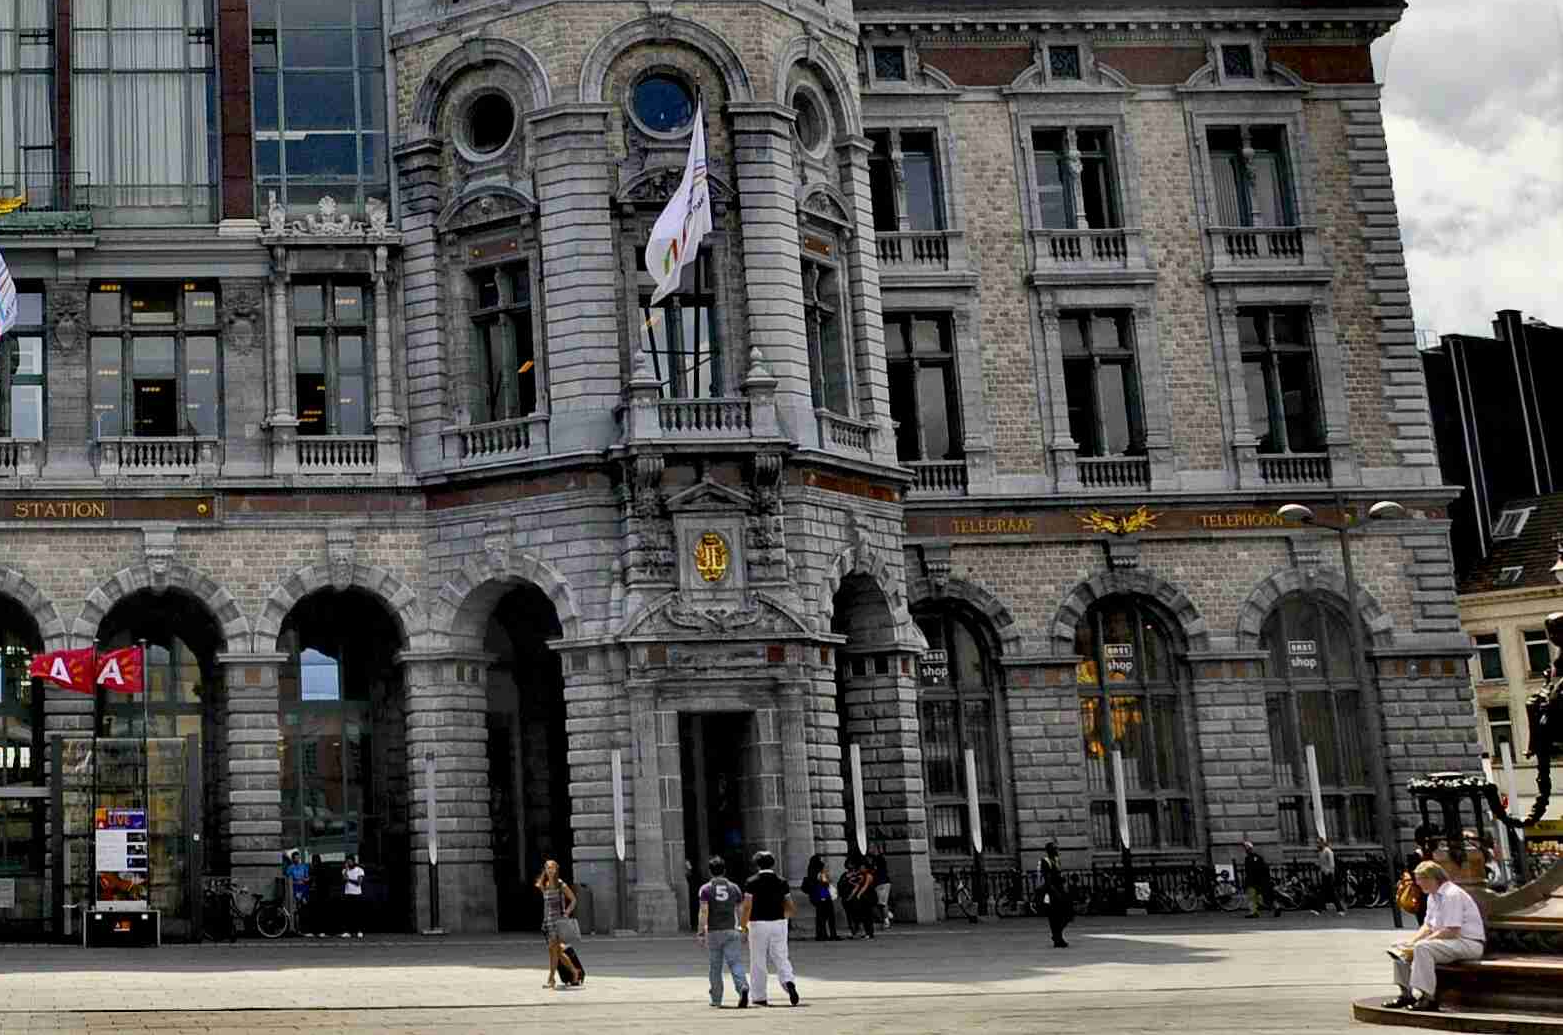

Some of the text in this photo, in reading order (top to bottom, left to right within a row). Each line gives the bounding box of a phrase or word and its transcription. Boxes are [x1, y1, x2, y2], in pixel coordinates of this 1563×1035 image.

[15, 502, 106, 518] STATION
[950, 517, 1036, 533] TELEGRAAF
[1200, 513, 1284, 526] TELEPHOON
[1108, 658, 1134, 673] shop
[1291, 655, 1318, 670] shop
[97, 657, 125, 685] A
[922, 664, 949, 678] shop
[715, 884, 729, 901] 5
